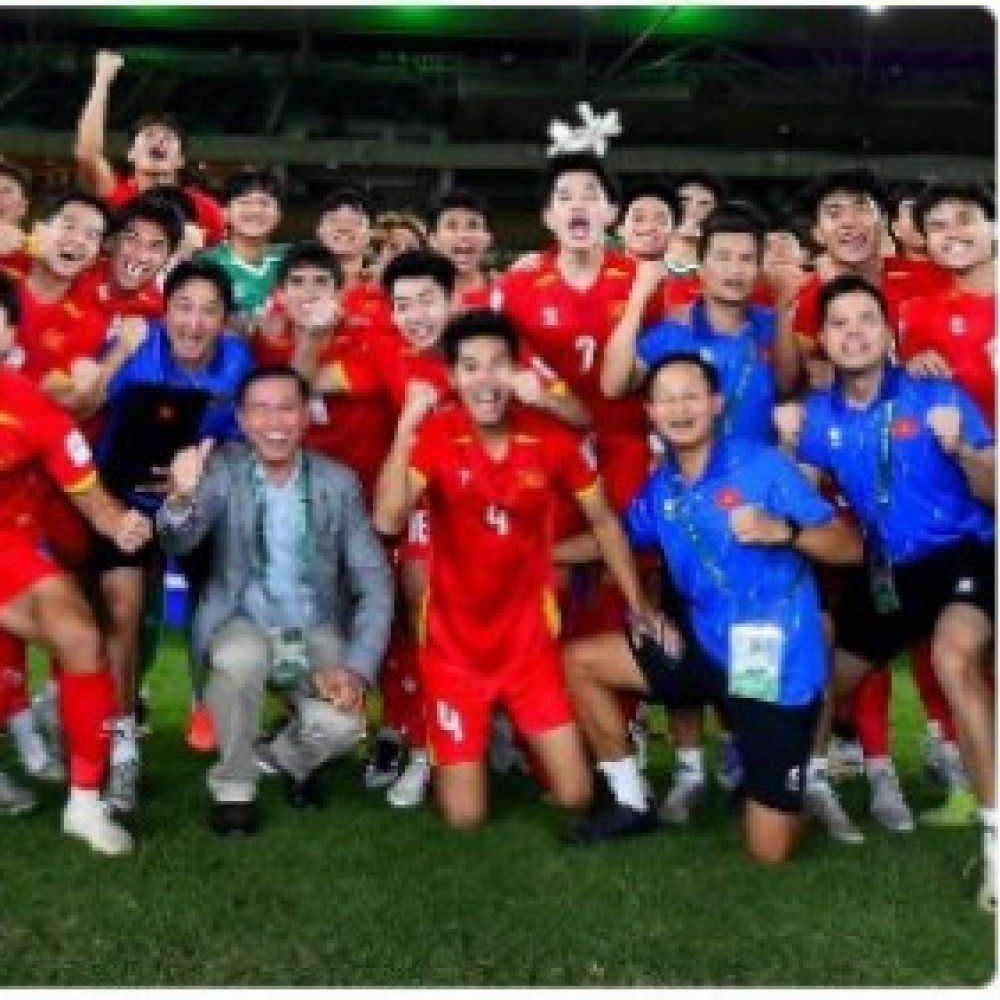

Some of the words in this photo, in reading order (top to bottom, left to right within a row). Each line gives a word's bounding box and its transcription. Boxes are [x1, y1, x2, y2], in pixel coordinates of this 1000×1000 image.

[573, 334, 599, 369] 7
[483, 502, 510, 537] 4
[436, 698, 464, 743] 4
